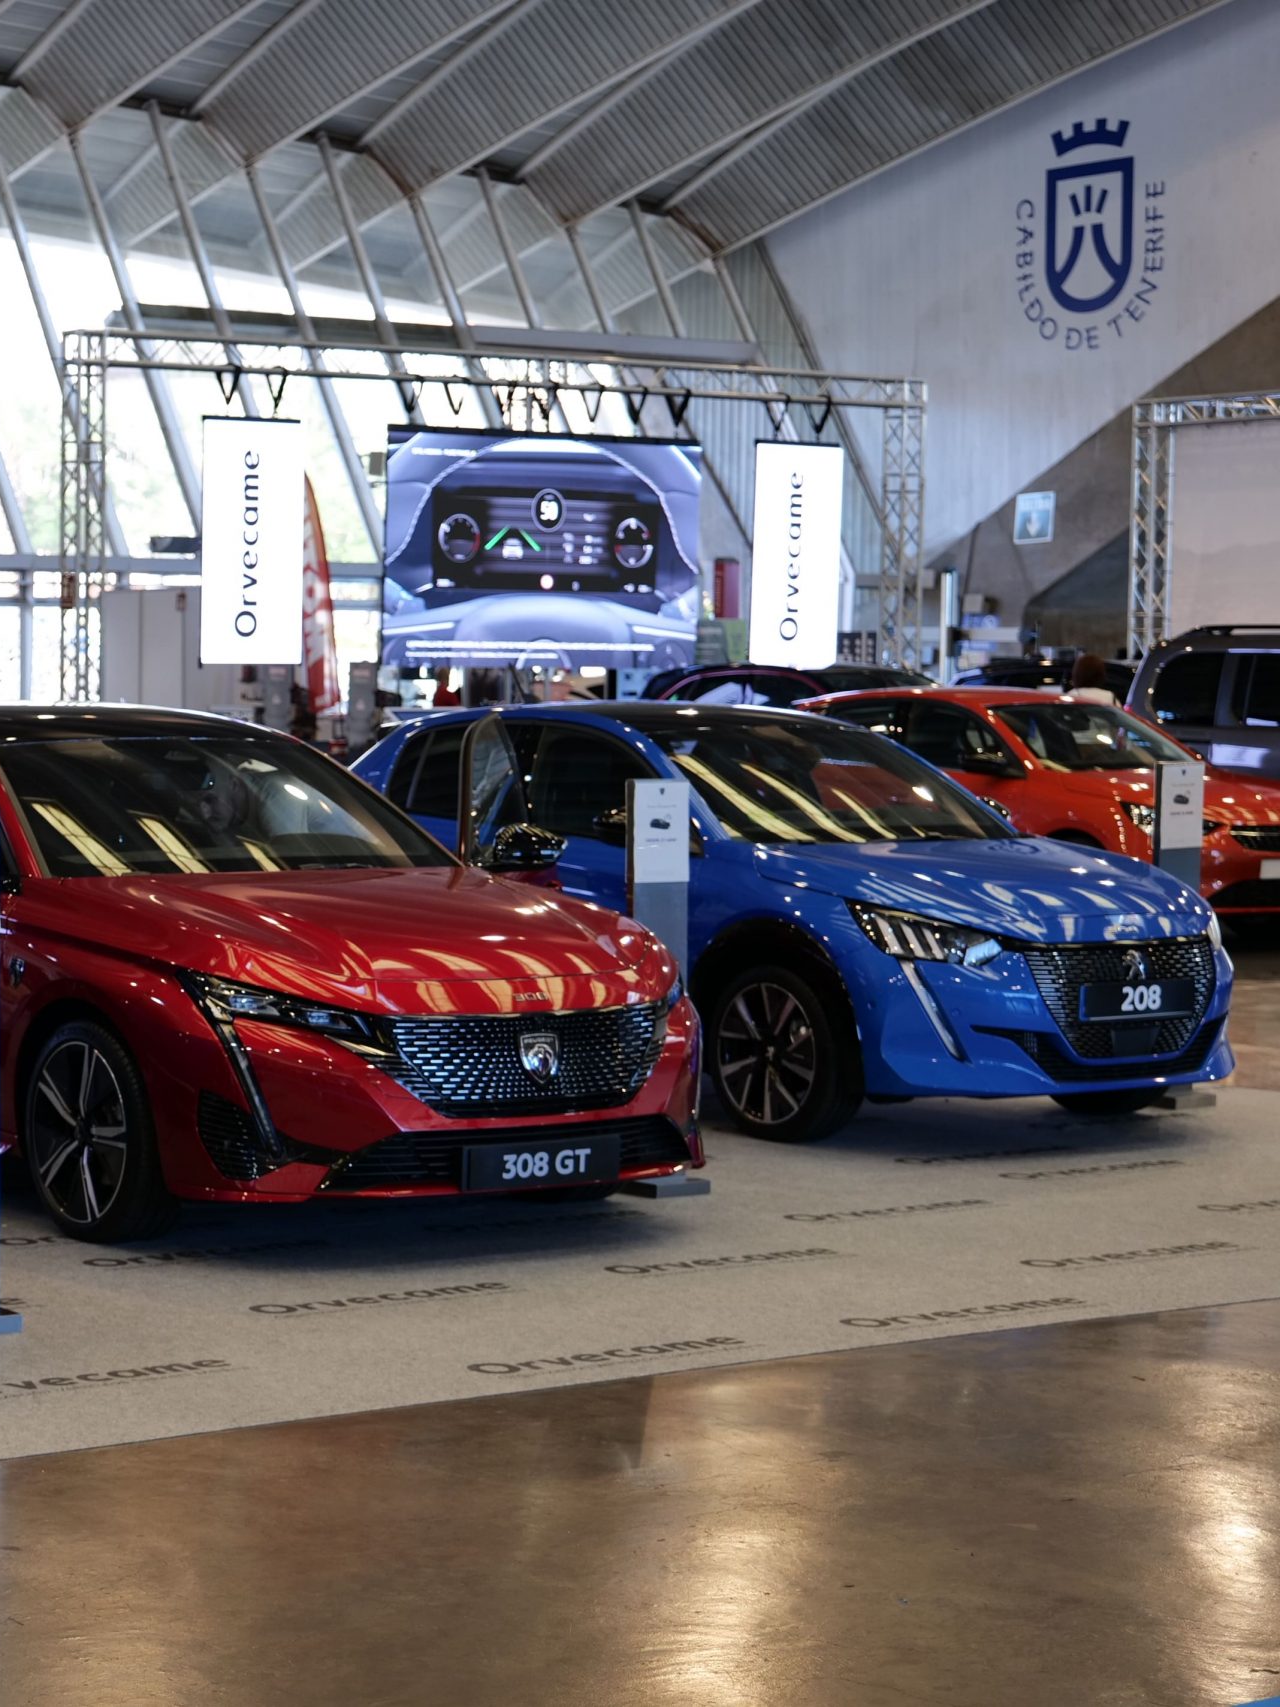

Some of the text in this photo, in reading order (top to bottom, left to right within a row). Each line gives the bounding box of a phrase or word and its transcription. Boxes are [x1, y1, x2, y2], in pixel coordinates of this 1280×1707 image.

[1015, 180, 1166, 351] CABILDO DE TENERIFE
[234, 450, 260, 638] Orvecame
[779, 471, 804, 642] Orvecame
[1121, 984, 1162, 1012] 208
[501, 1148, 592, 1180] 308 GT
[604, 1247, 838, 1275] Orvecame
[1020, 1241, 1239, 1268] Orvecame
[249, 1282, 508, 1314] Orvecame
[839, 1297, 1086, 1328] Orvecame
[467, 1335, 745, 1374] Orvecame
